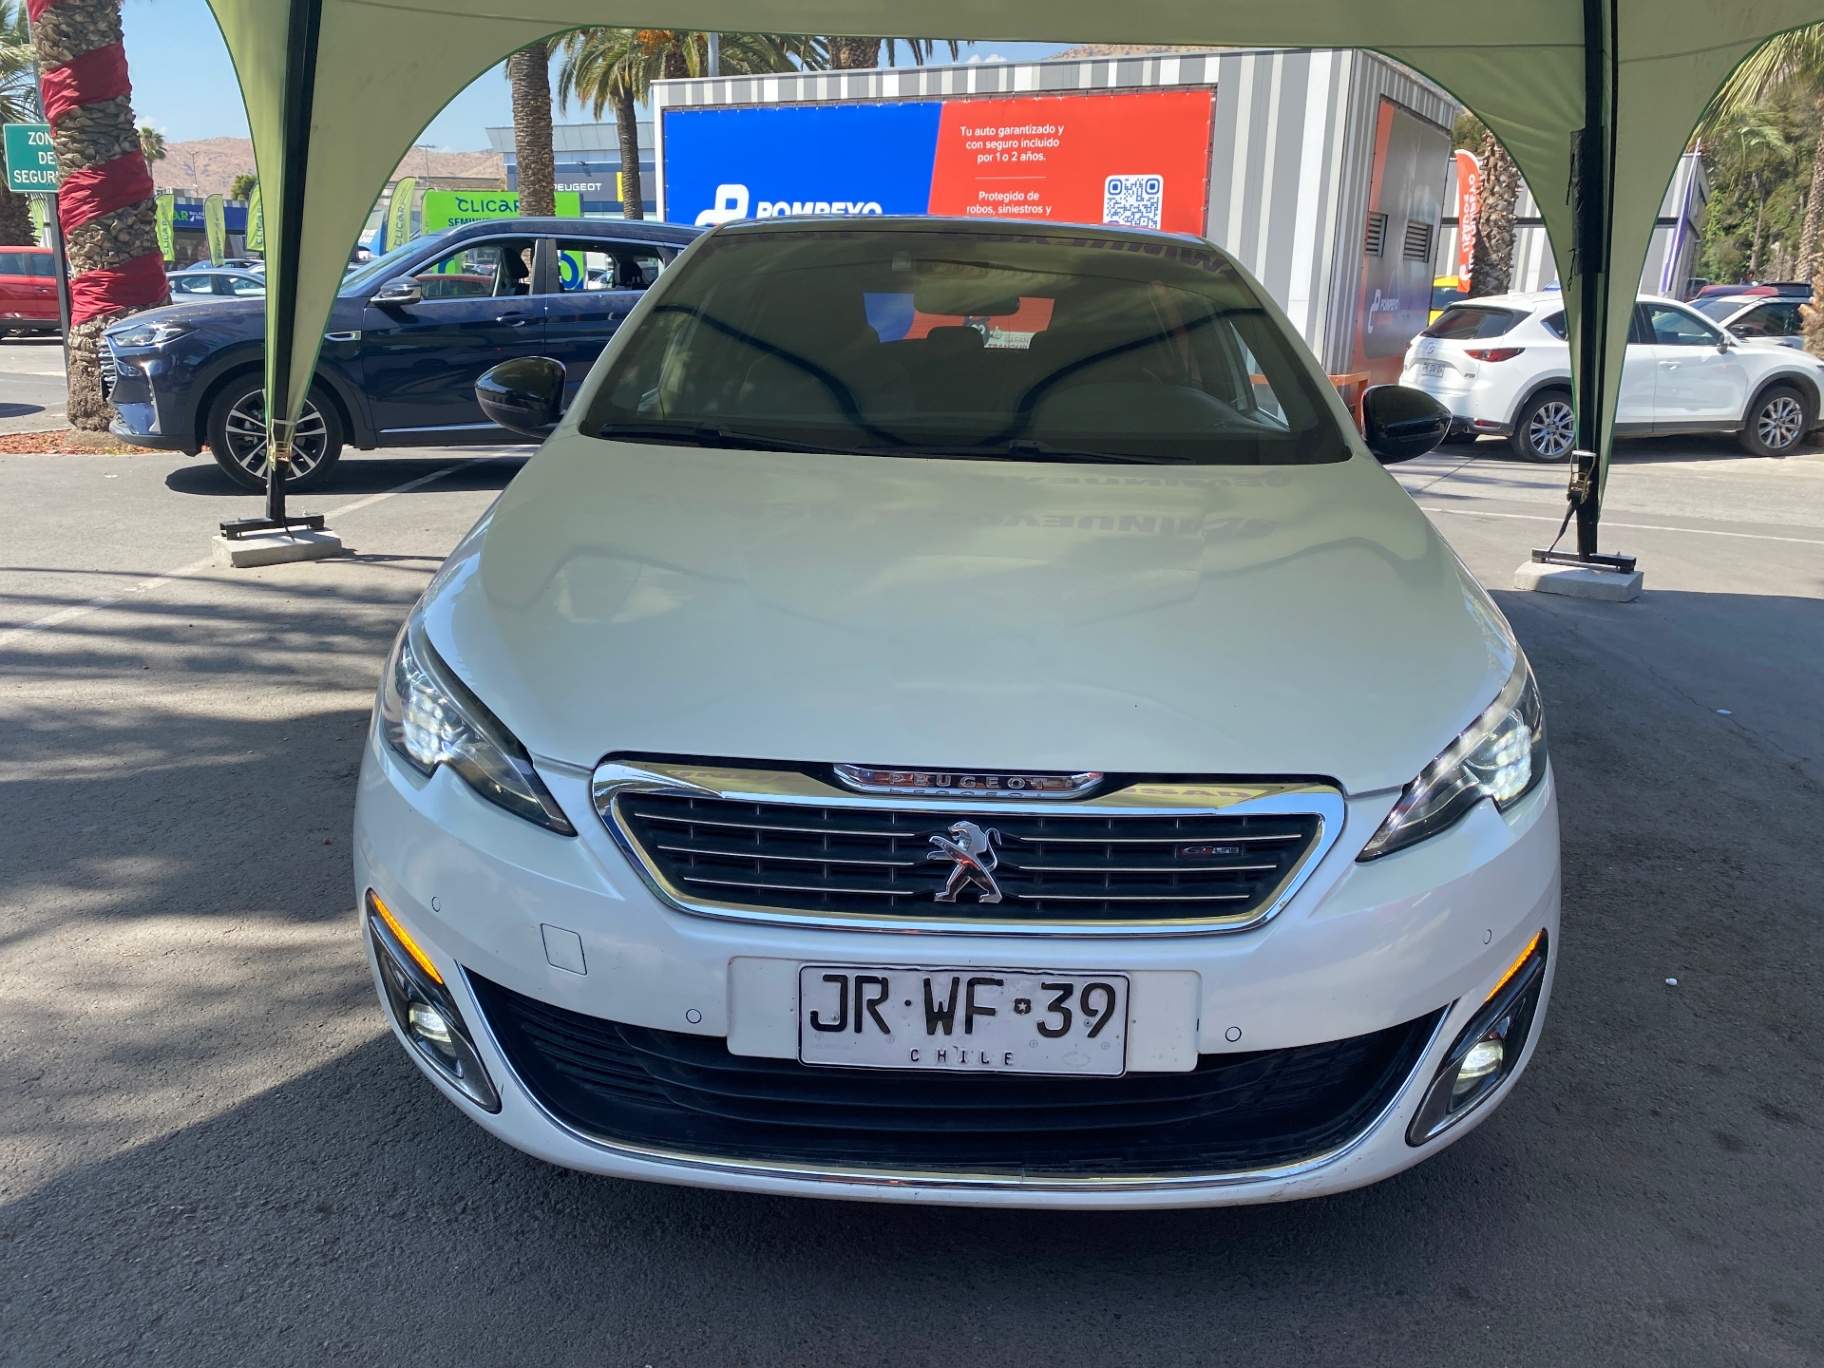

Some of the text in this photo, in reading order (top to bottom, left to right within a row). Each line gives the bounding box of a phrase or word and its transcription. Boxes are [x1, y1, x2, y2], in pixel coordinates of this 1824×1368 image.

[960, 124, 1064, 137] Tu auto garantizado y
[27, 132, 54, 145] ZON
[985, 140, 1019, 150] seguro
[1021, 138, 1059, 148] incluido
[38, 151, 55, 165] DE
[977, 154, 993, 164] por
[995, 152, 1000, 160] 1
[1012, 152, 1018, 160] 2
[1020, 151, 1046, 161] años.
[13, 170, 58, 184] SEGUR
[978, 191, 1040, 202] Protegido de
[967, 204, 1052, 215] robos, siniestros y
[889, 772, 1048, 790] PEUGEOT
[910, 1049, 1015, 1065] CHILE
